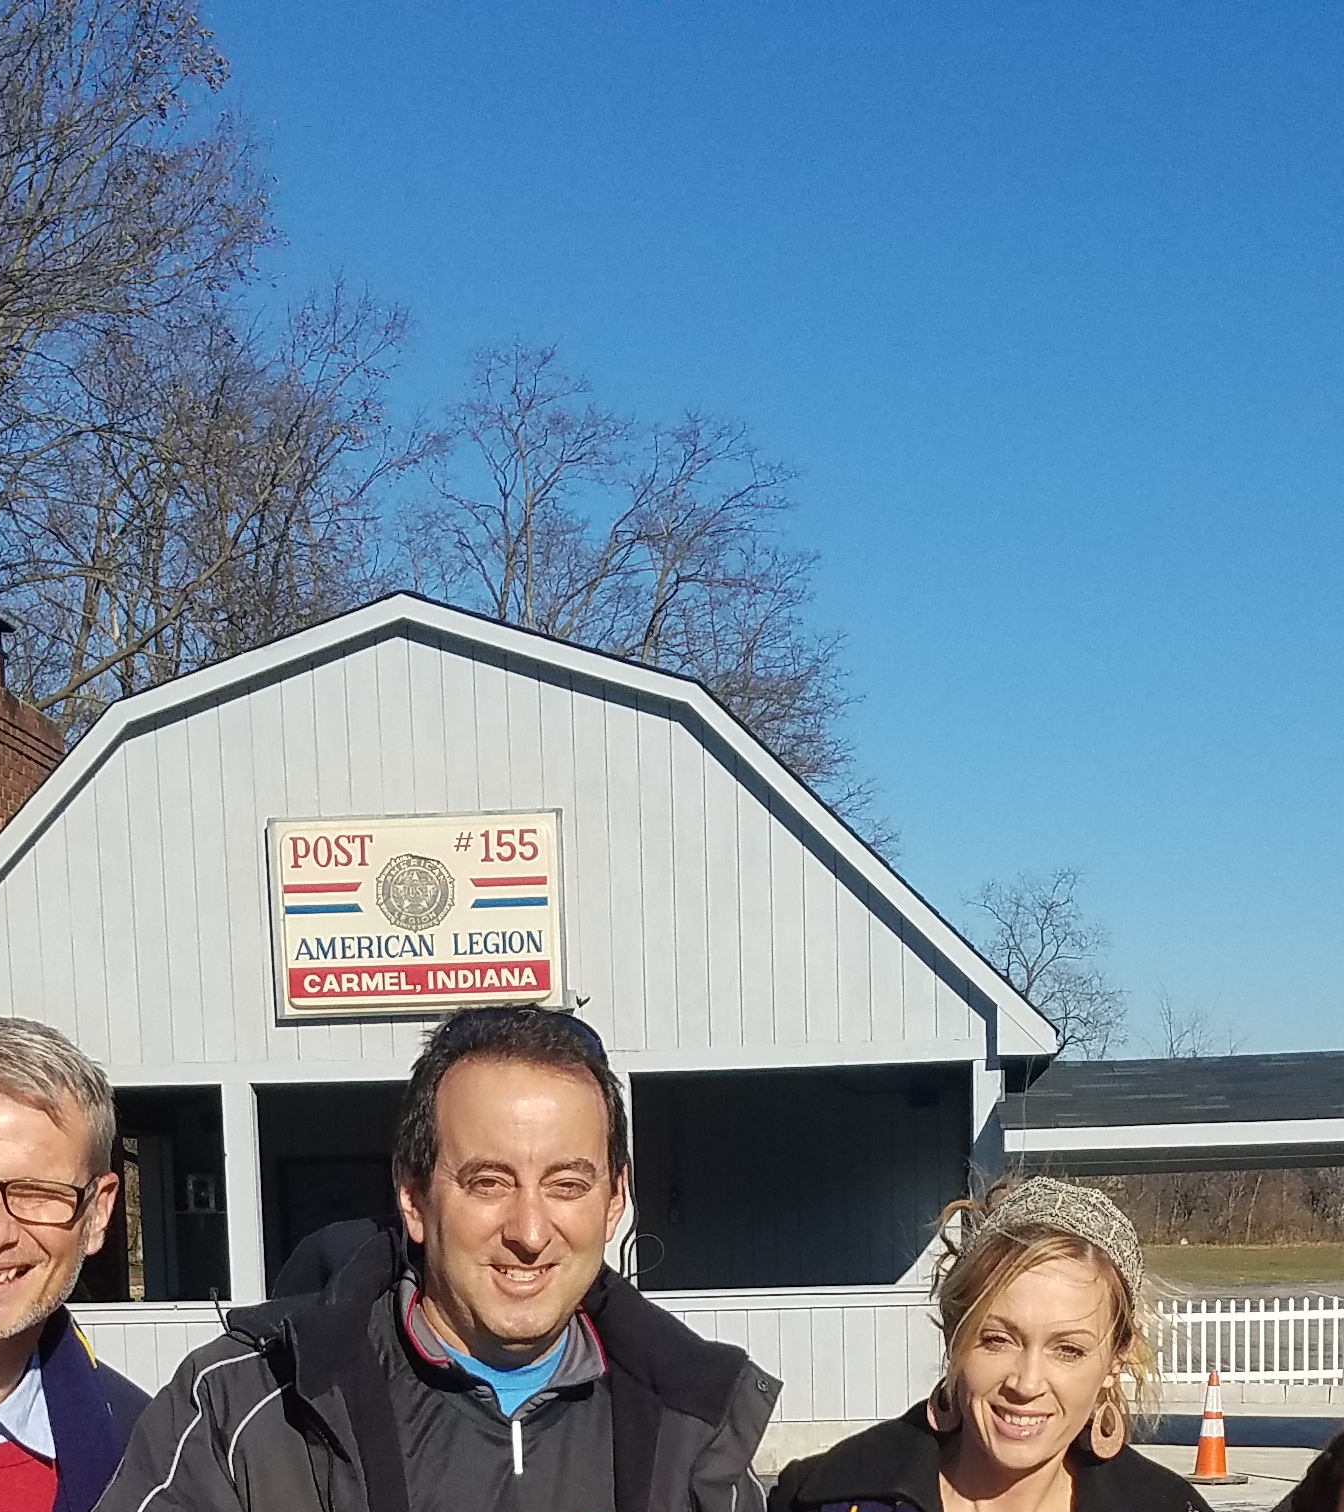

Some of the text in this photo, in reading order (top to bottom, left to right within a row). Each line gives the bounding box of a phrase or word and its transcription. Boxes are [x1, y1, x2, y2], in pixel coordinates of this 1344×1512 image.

[289, 828, 539, 868] POST #155
[386, 859, 445, 883] AMERICAN
[394, 911, 437, 924] LEGION
[294, 929, 543, 961] AMERICAN LEGION
[303, 967, 538, 993] CARMEL, INDIANA
